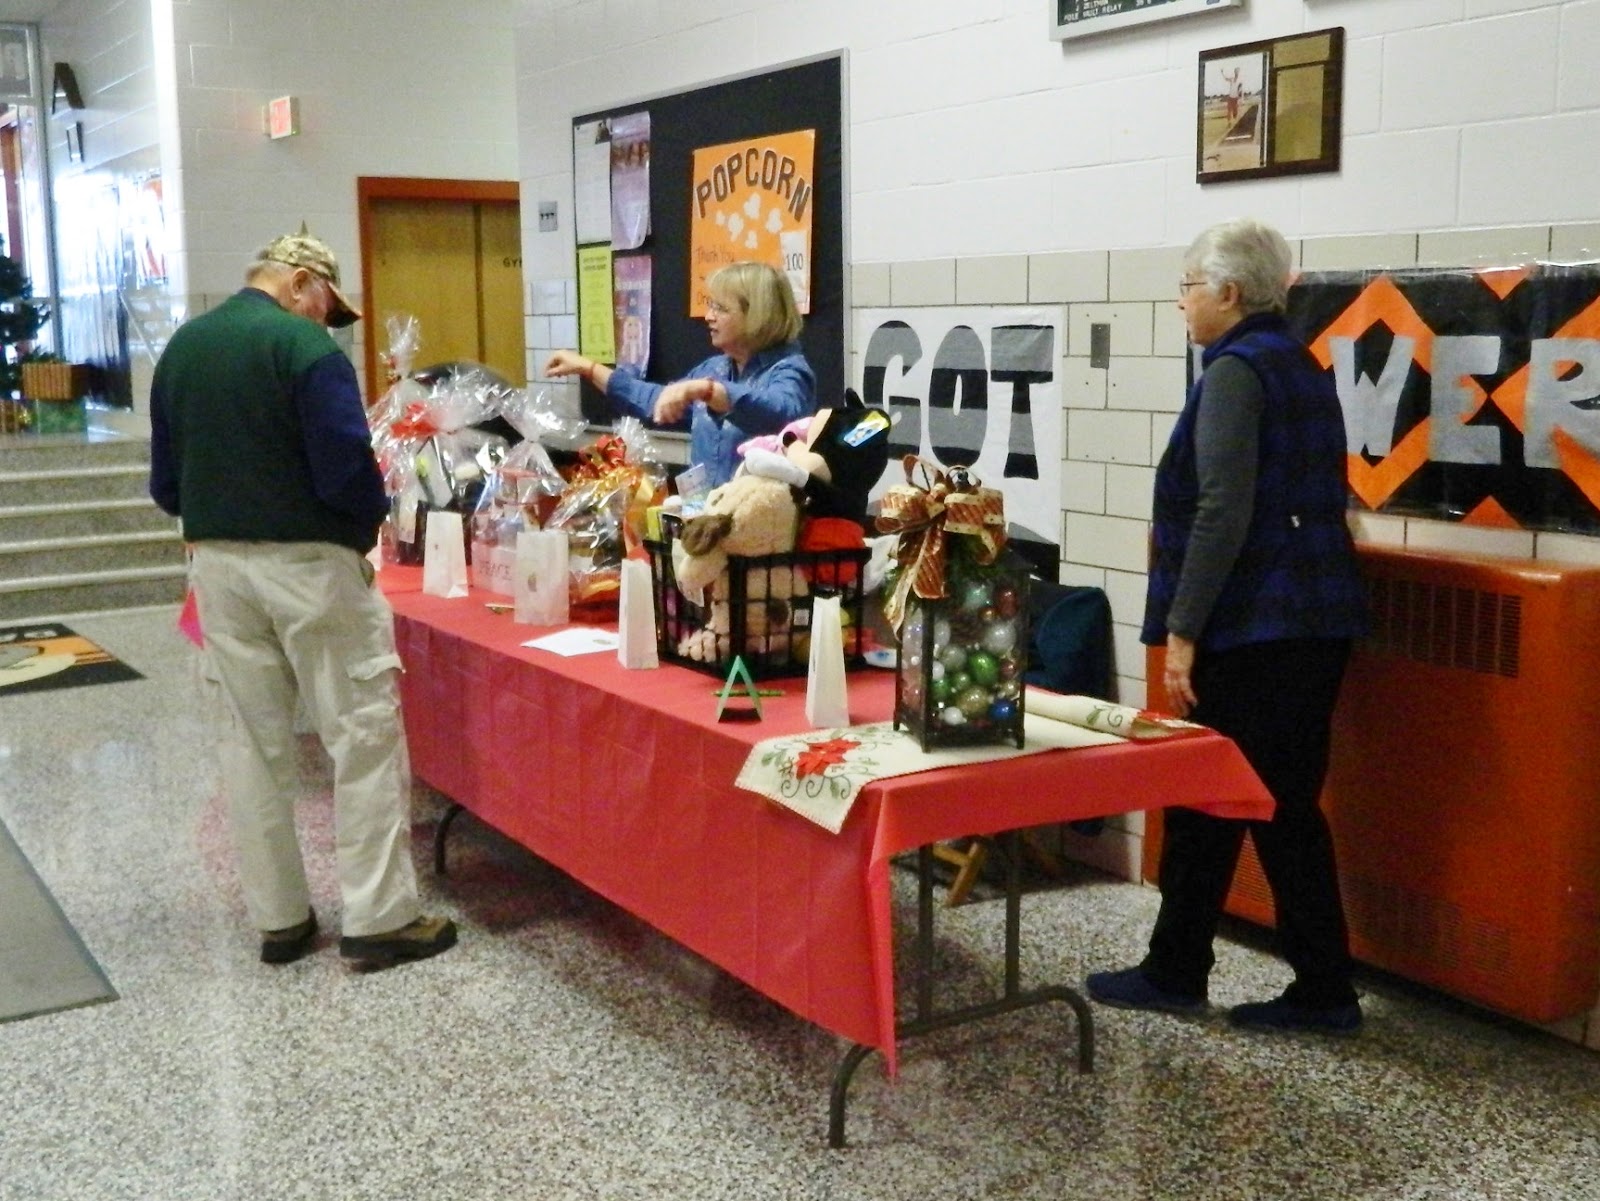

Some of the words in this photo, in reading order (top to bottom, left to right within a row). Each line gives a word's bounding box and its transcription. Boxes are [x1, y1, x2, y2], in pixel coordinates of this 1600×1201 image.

[696, 147, 811, 222] POPCORN
[502, 256, 522, 268] GY
[785, 252, 804, 271] 100
[862, 319, 1055, 481] GOT
[1327, 334, 1600, 470] WER
